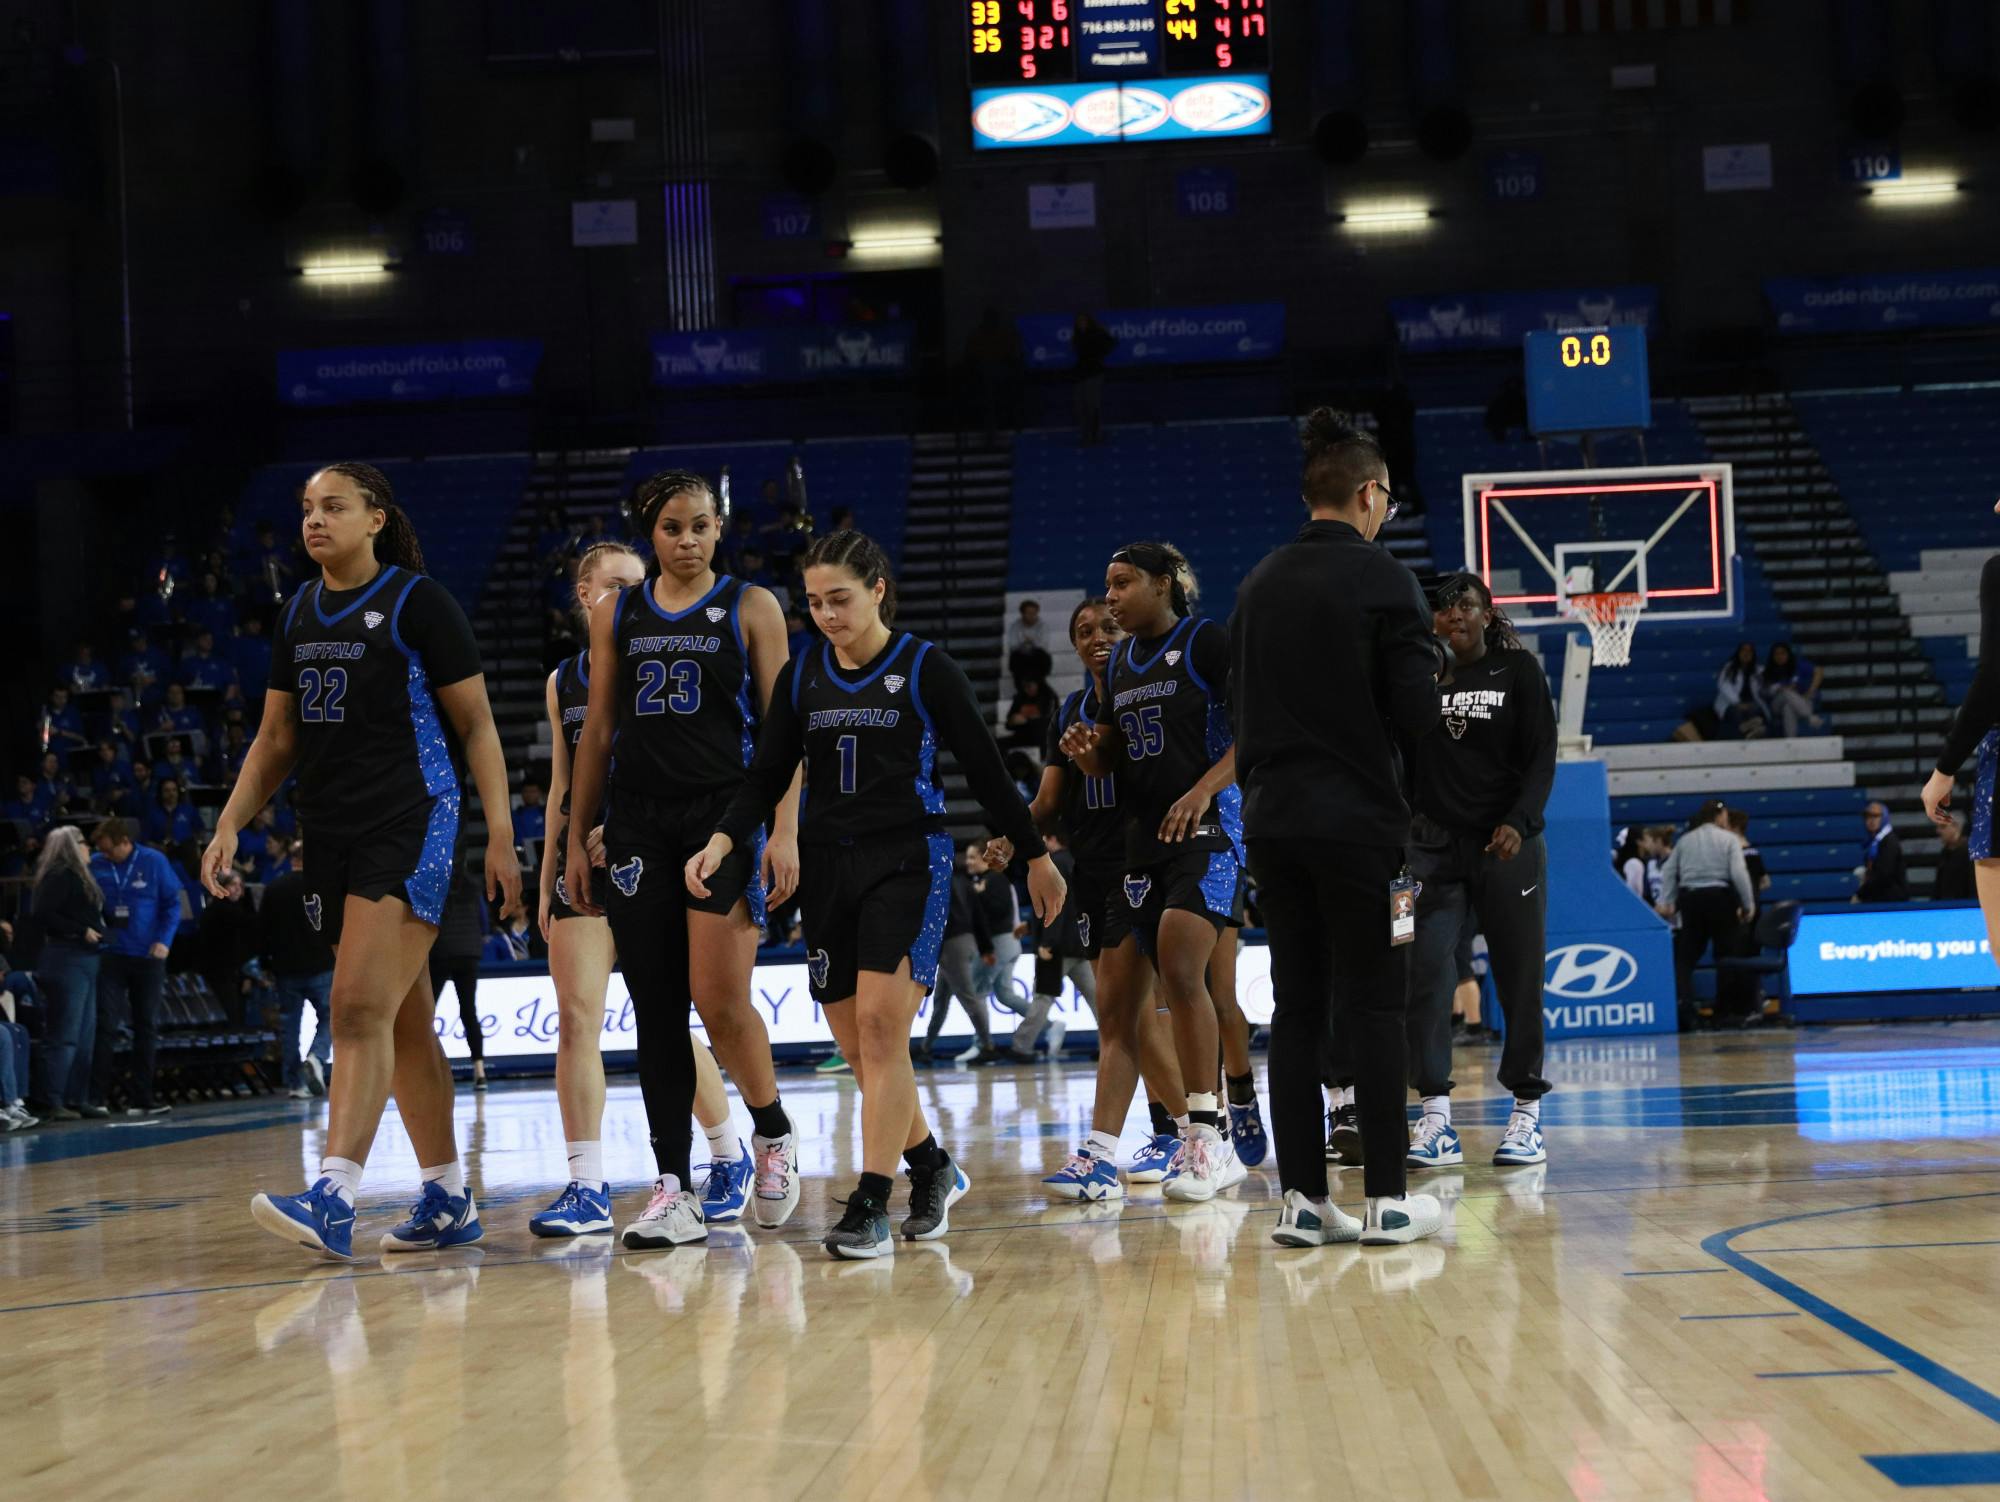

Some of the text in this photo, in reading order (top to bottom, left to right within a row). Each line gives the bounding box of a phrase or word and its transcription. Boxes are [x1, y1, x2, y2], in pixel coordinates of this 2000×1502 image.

[972, 0, 1068, 25] 33 4 6
[1166, 14, 1264, 40] 44 4 17
[973, 28, 1001, 53] 35
[1021, 54, 1036, 78] 5
[1216, 43, 1232, 67] 5
[1850, 155, 1890, 178] 110
[1494, 174, 1537, 197] 109
[1187, 190, 1229, 213] 108
[771, 213, 812, 236] 107
[424, 231, 464, 252] 106
[1803, 283, 2000, 308] audenbuffalo.com
[1056, 318, 1247, 342] anbuffalo.com
[1561, 335, 1611, 367] 0.0
[294, 641, 367, 663] BUFFALO
[625, 635, 721, 657] BUFFALO
[299, 666, 348, 722] 22
[635, 659, 702, 716] 23
[1113, 679, 1178, 712] BUFFALO
[1452, 689, 1506, 707] HISTORY
[808, 708, 900, 732] BUFFALO
[1468, 711, 1492, 720] FUTURE
[1472, 704, 1489, 712] PAST
[1119, 704, 1165, 761] 35
[836, 734, 858, 793] 1
[1819, 940, 1933, 962] Everything
[1936, 939, 1976, 959] you
[514, 996, 636, 1042] Loal
[1542, 1001, 1656, 1030] YUNDAI
